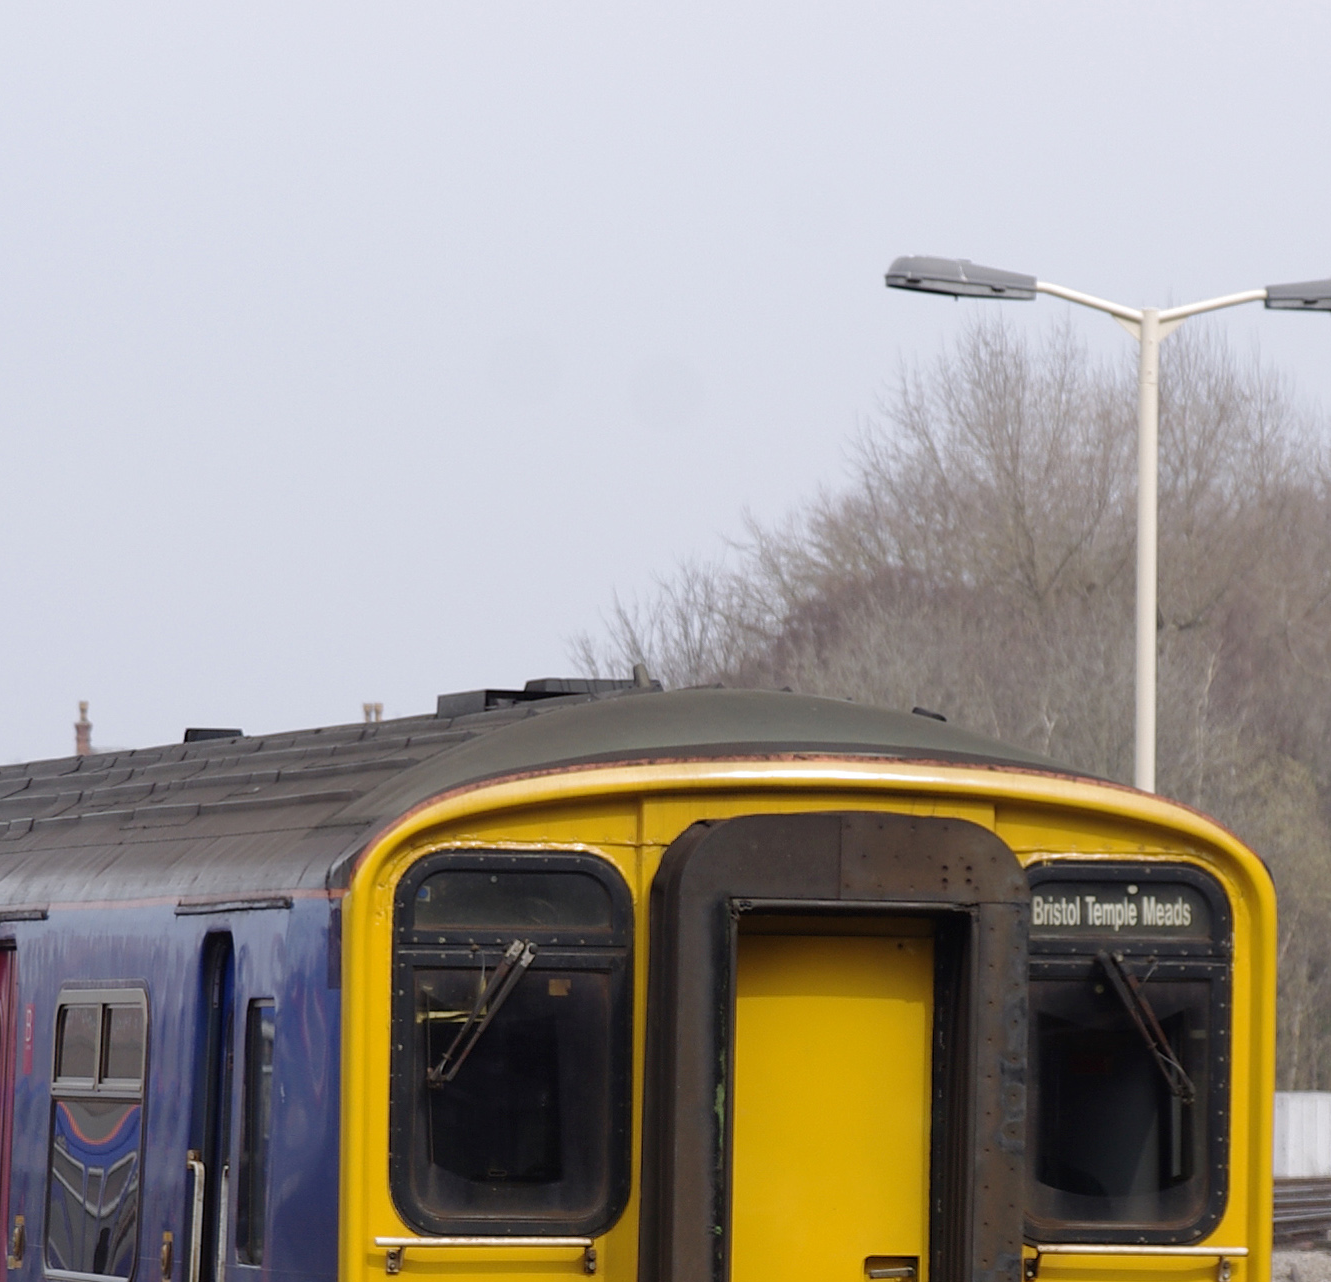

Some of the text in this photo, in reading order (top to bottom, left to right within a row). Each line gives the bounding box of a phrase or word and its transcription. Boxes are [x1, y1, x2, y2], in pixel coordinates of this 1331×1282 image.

[1032, 896, 1192, 931] Bristol Temple Meads
